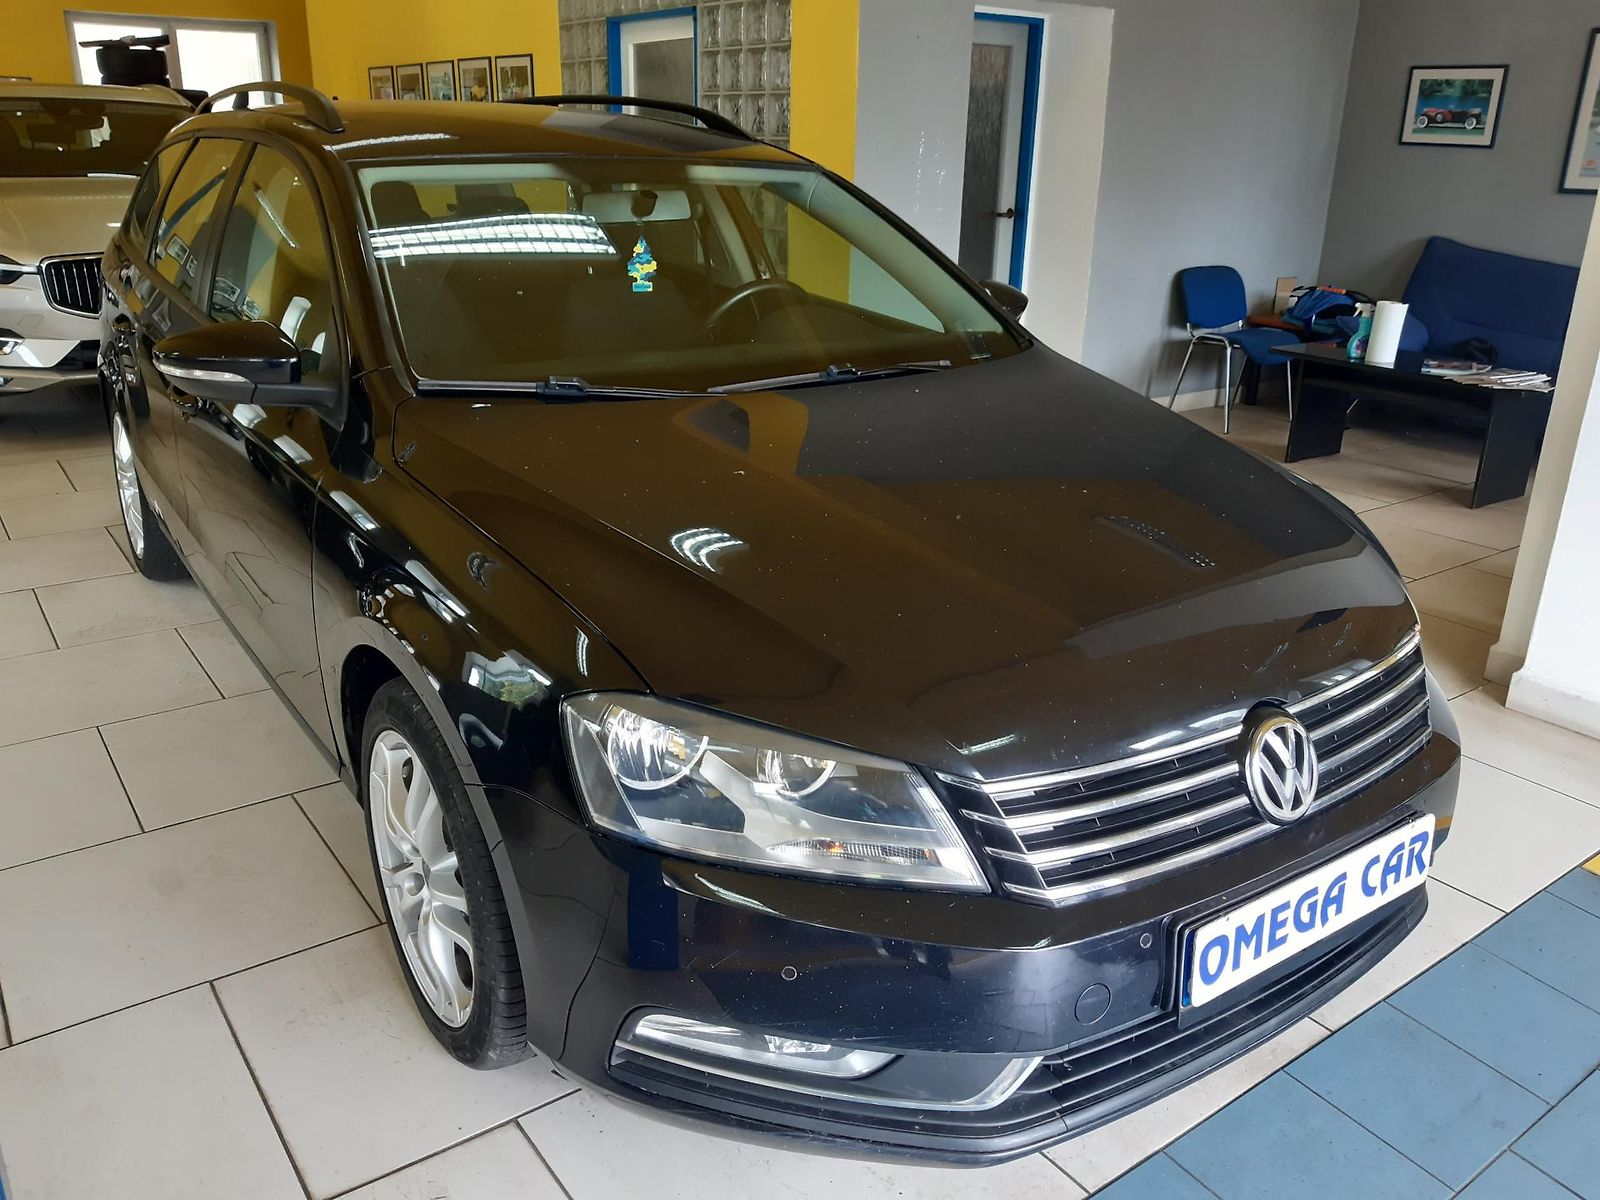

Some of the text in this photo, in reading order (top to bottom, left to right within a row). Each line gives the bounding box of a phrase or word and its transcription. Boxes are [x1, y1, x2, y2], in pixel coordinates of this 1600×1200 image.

[1249, 718, 1317, 819] VW
[1199, 830, 1430, 986] OMEGA CAR
